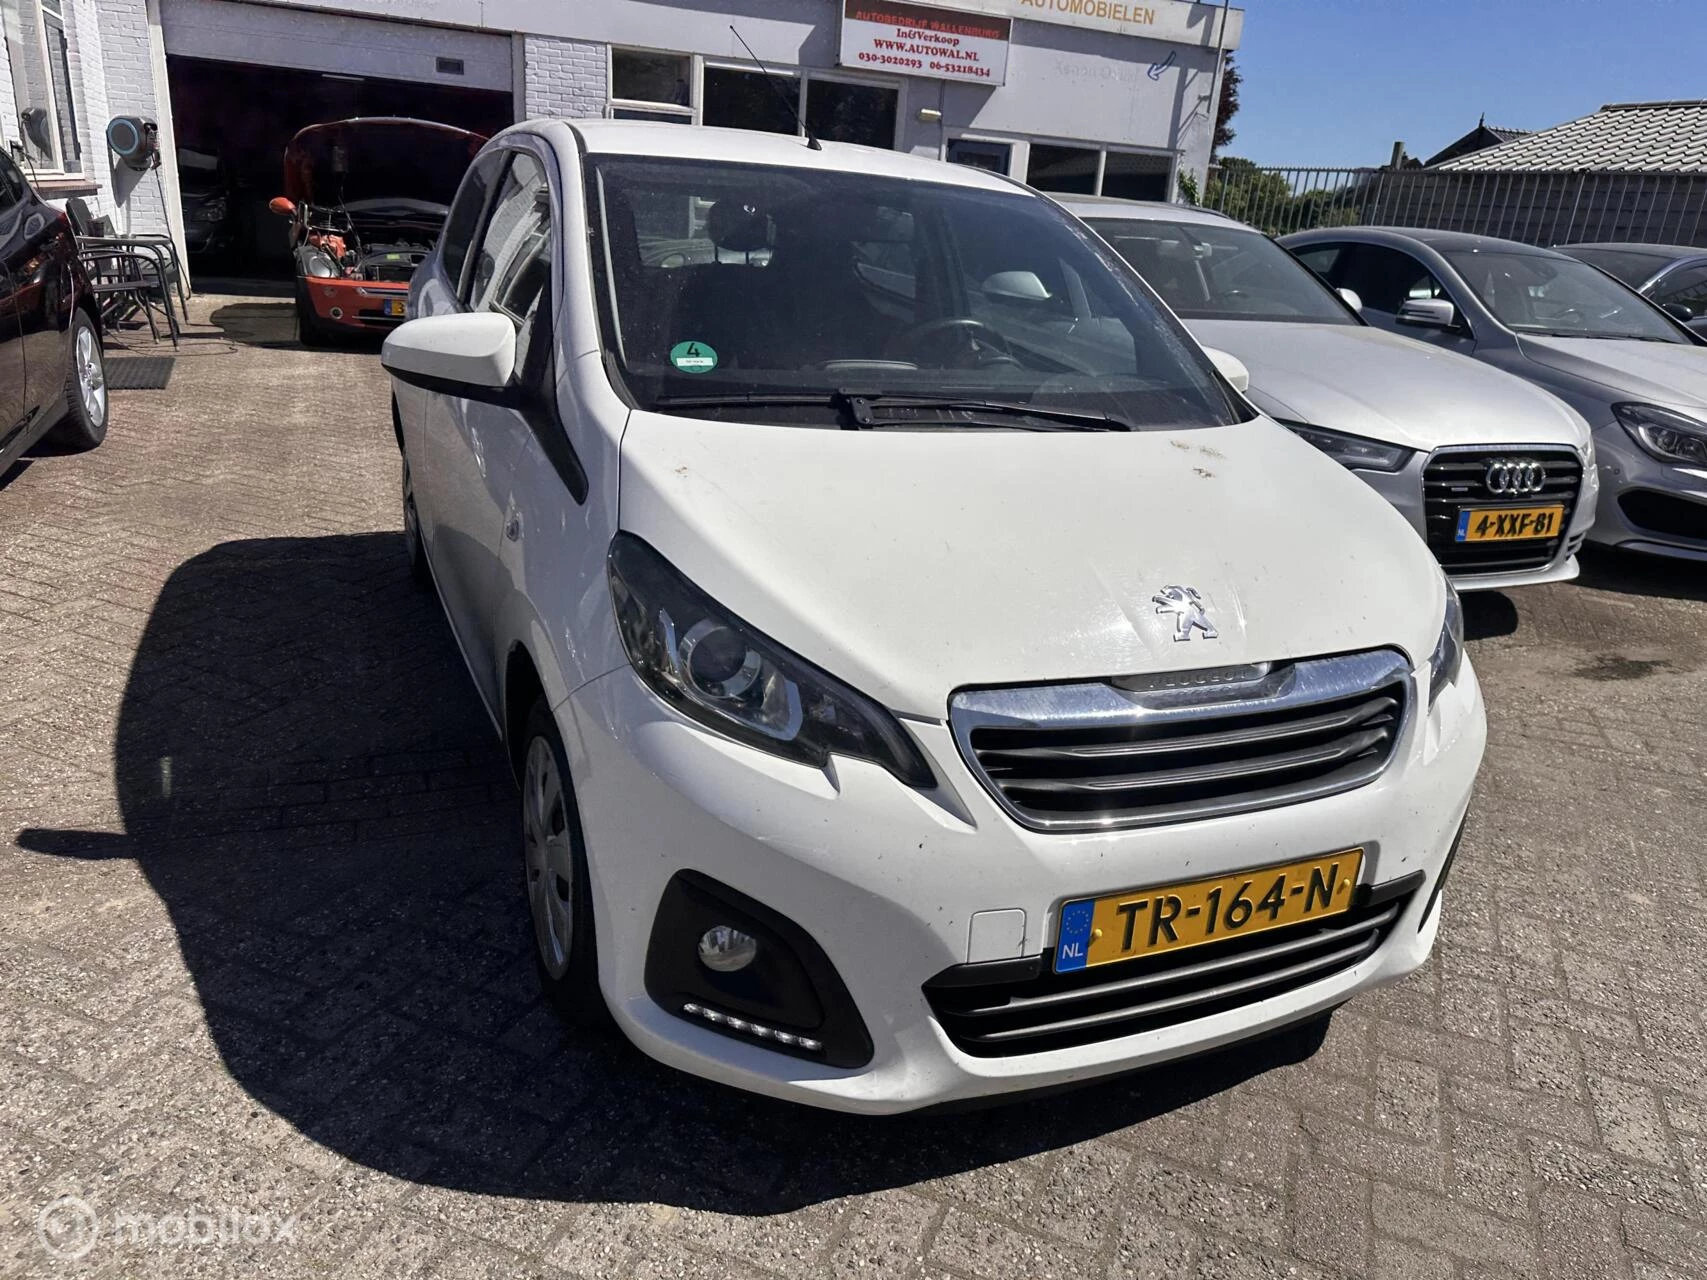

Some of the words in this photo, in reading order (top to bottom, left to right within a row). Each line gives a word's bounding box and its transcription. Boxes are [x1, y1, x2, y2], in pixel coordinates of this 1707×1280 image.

[896, 28, 960, 47] In&Verkoop
[873, 39, 979, 61] WWW.AUTOWAL.NL
[687, 343, 700, 357] 4
[1475, 512, 1554, 537] 4-XXF-81
[1062, 943, 1083, 959] NL
[1115, 861, 1340, 951] TR-164-N
